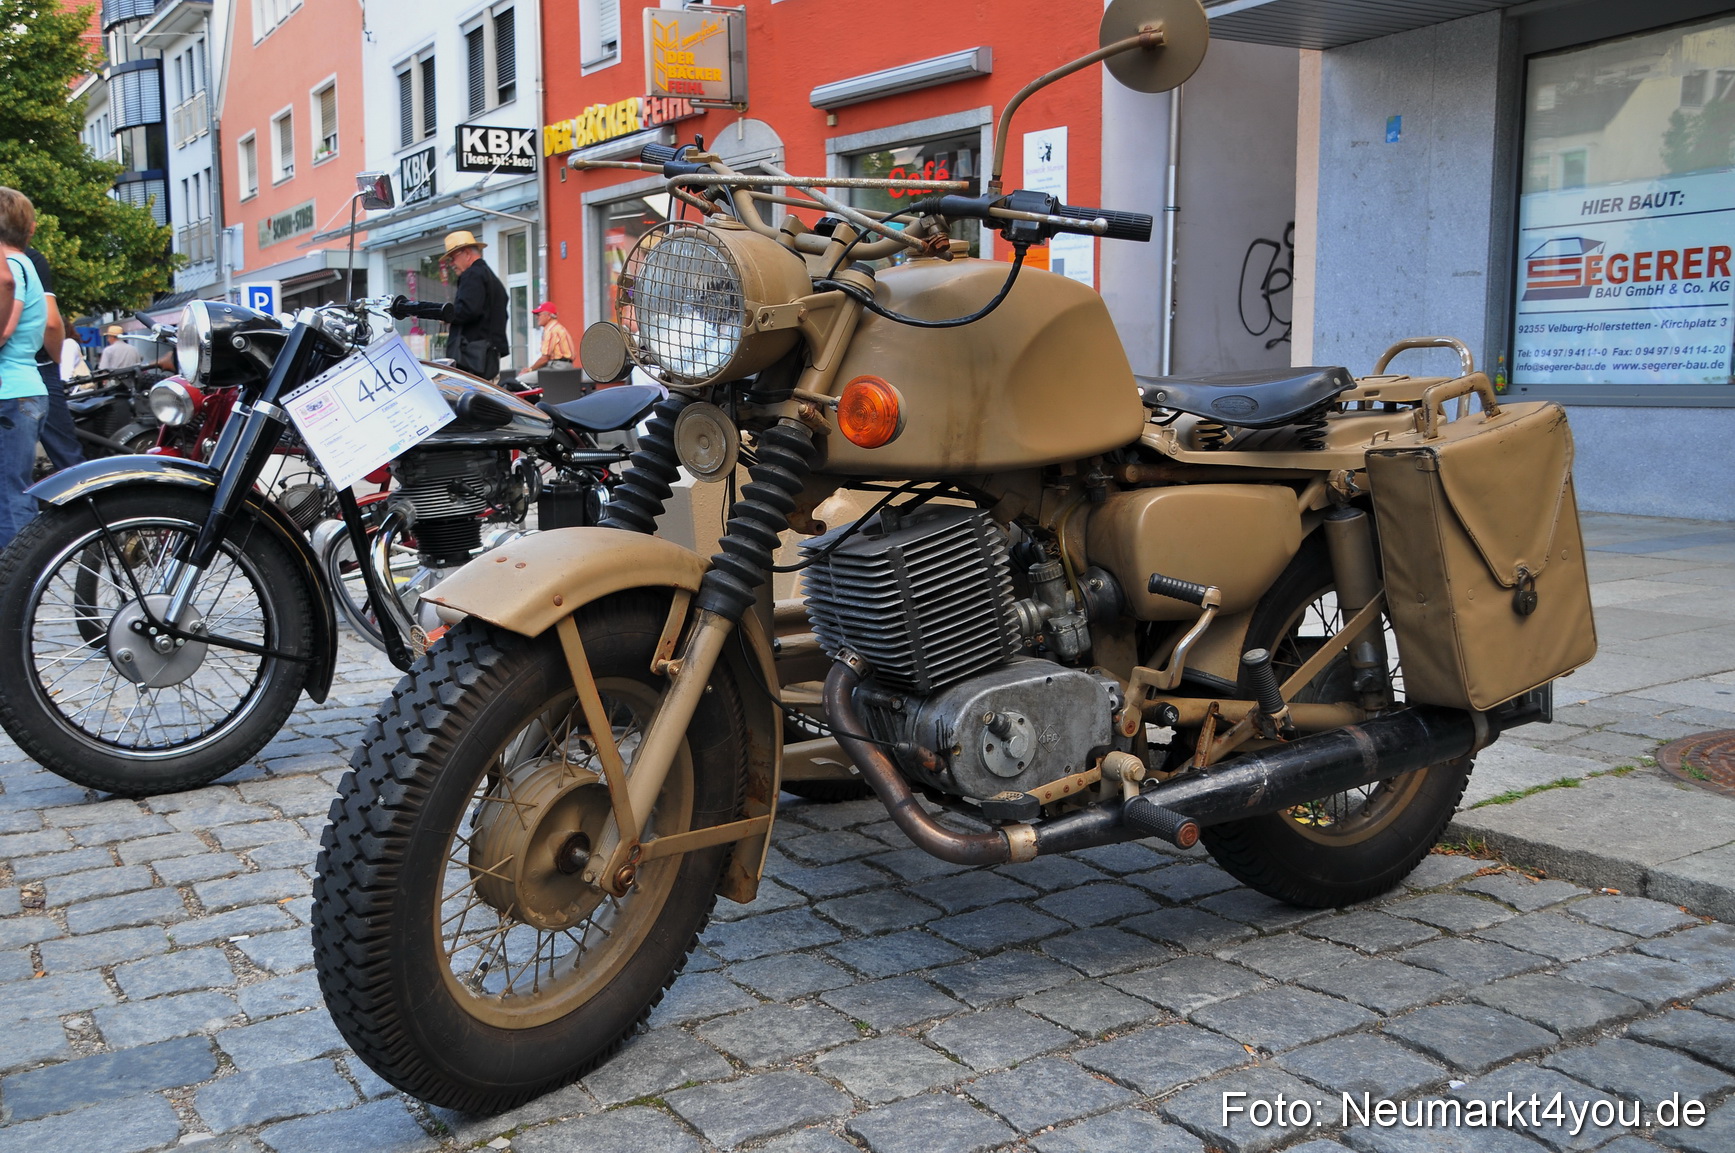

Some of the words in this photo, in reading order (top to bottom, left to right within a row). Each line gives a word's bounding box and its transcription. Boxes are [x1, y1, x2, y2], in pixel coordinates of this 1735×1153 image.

[667, 51, 695, 65] DER
[667, 64, 723, 82] BÄCKER
[668, 80, 705, 95] FEIHL
[543, 118, 573, 157] DER
[575, 97, 640, 148] BÄCKER
[462, 127, 536, 156] KBK
[402, 150, 431, 189] KBK
[888, 160, 950, 199] Café
[1581, 197, 1623, 216] HIER
[1628, 190, 1685, 211] BAUT:
[1526, 245, 1732, 289] SEGERER
[1595, 287, 1622, 299] BAU
[1625, 284, 1665, 297] GmbH
[1668, 283, 1677, 295] &
[1683, 283, 1704, 294] Co.
[1709, 280, 1730, 292] KG
[254, 292, 270, 313] P
[1518, 324, 1545, 334] 92355
[1548, 321, 1651, 334] Velburg-Hollerstetten
[1660, 318, 1717, 330] Kirchplatz
[1720, 317, 1727, 328] 3
[1517, 349, 1532, 358] Tel:
[1612, 348, 1632, 357] Fax:
[1516, 362, 1606, 373] info@segerer-bau.de
[1612, 360, 1725, 373] www.segerer-bau.de
[358, 356, 408, 402] 446
